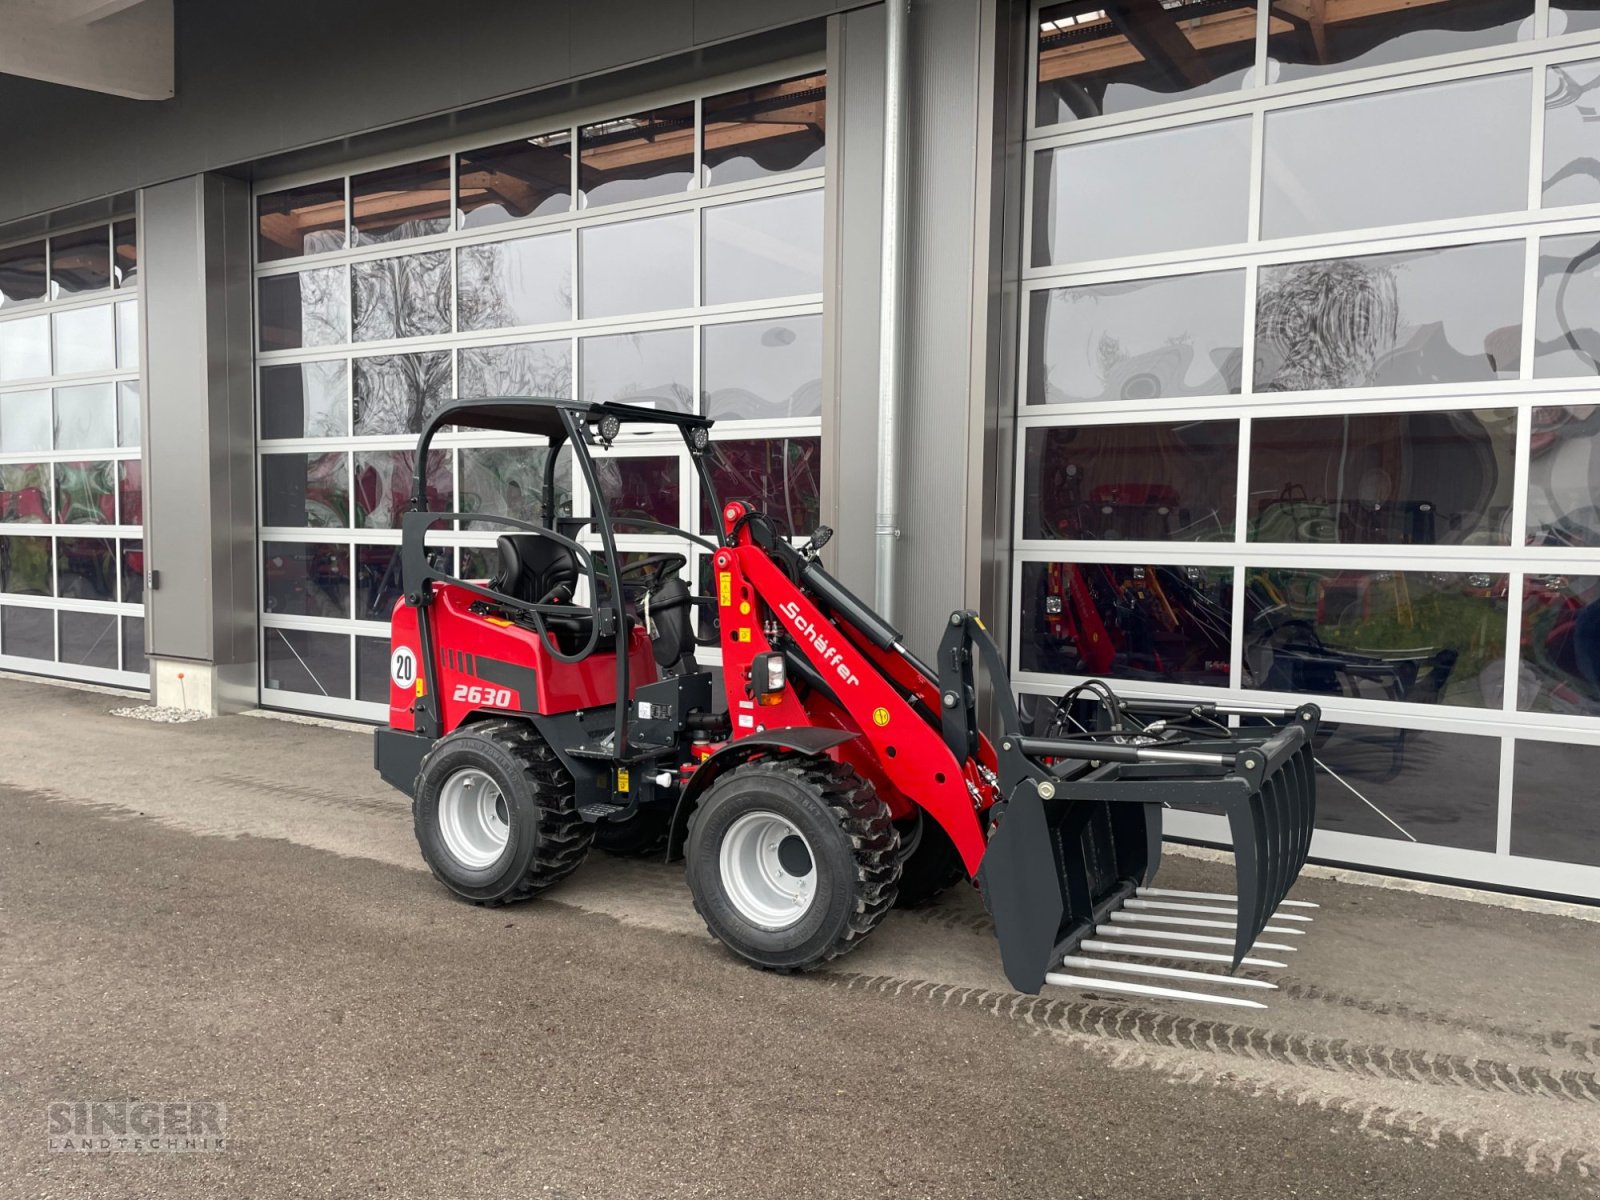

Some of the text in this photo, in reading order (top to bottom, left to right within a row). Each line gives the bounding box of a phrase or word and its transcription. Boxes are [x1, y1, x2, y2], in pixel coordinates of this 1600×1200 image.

[779, 602, 859, 686] Schäffer
[397, 655, 411, 680] 20
[453, 684, 511, 707] 2630
